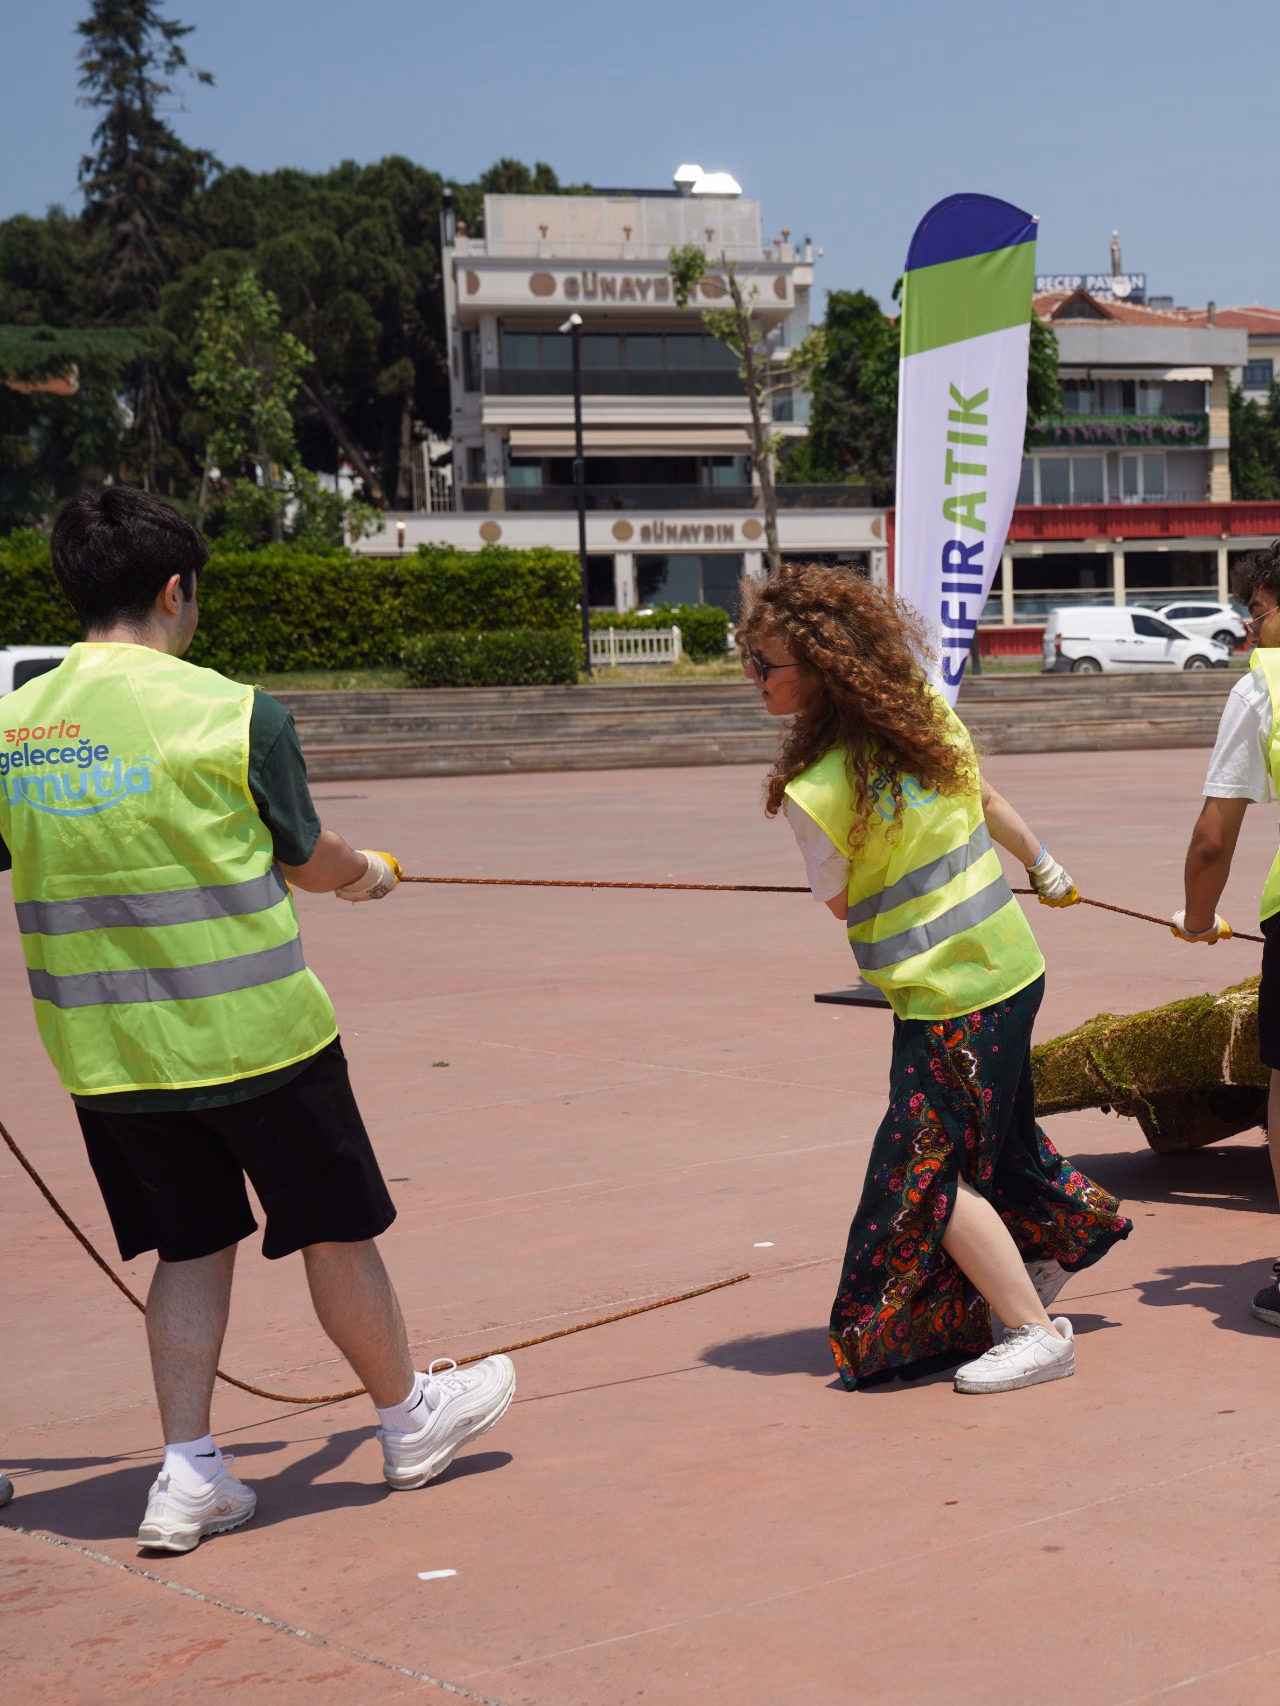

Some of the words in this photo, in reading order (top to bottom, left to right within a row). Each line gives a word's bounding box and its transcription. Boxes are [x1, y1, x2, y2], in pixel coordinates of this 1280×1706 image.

[1086, 275, 1144, 291] PAYN
[640, 520, 734, 543] GÜNAYDIN
[4, 719, 81, 746] sporla
[0, 739, 110, 775] geleceğe
[2, 756, 151, 806] umutla
